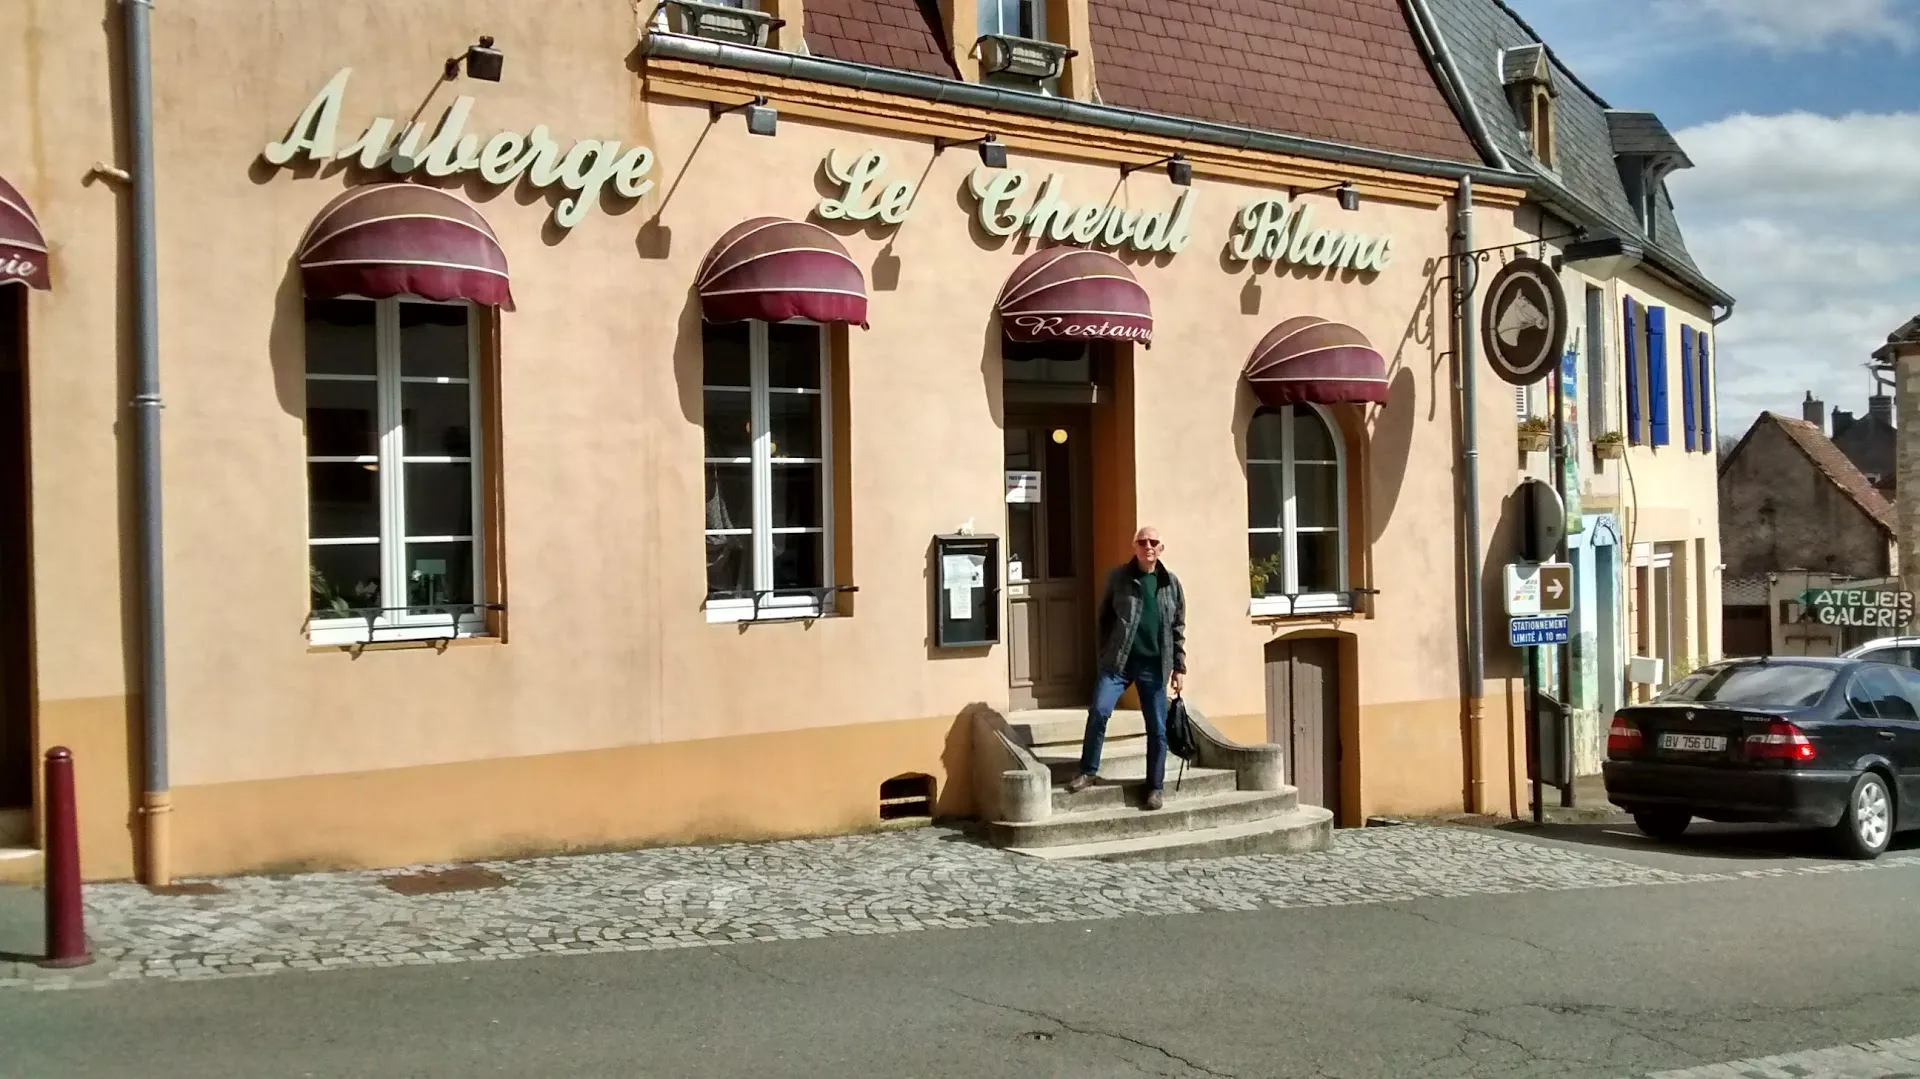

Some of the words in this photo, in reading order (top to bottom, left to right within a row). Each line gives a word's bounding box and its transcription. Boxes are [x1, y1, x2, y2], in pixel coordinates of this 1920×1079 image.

[265, 67, 655, 229] Auberge
[818, 148, 915, 224] Le
[966, 165, 1198, 254] Cheval
[1228, 198, 1394, 273] Blanc
[1814, 590, 1913, 608] ATELIER
[1512, 619, 1567, 632] STATIONNEMENT
[1819, 606, 1912, 628] GALERIE
[1512, 631, 1536, 643] LIMITÉ
[1538, 631, 1543, 642] À
[1545, 632, 1554, 641] 10
[1665, 735, 1678, 748] BV
[1682, 736, 1701, 749] 756
